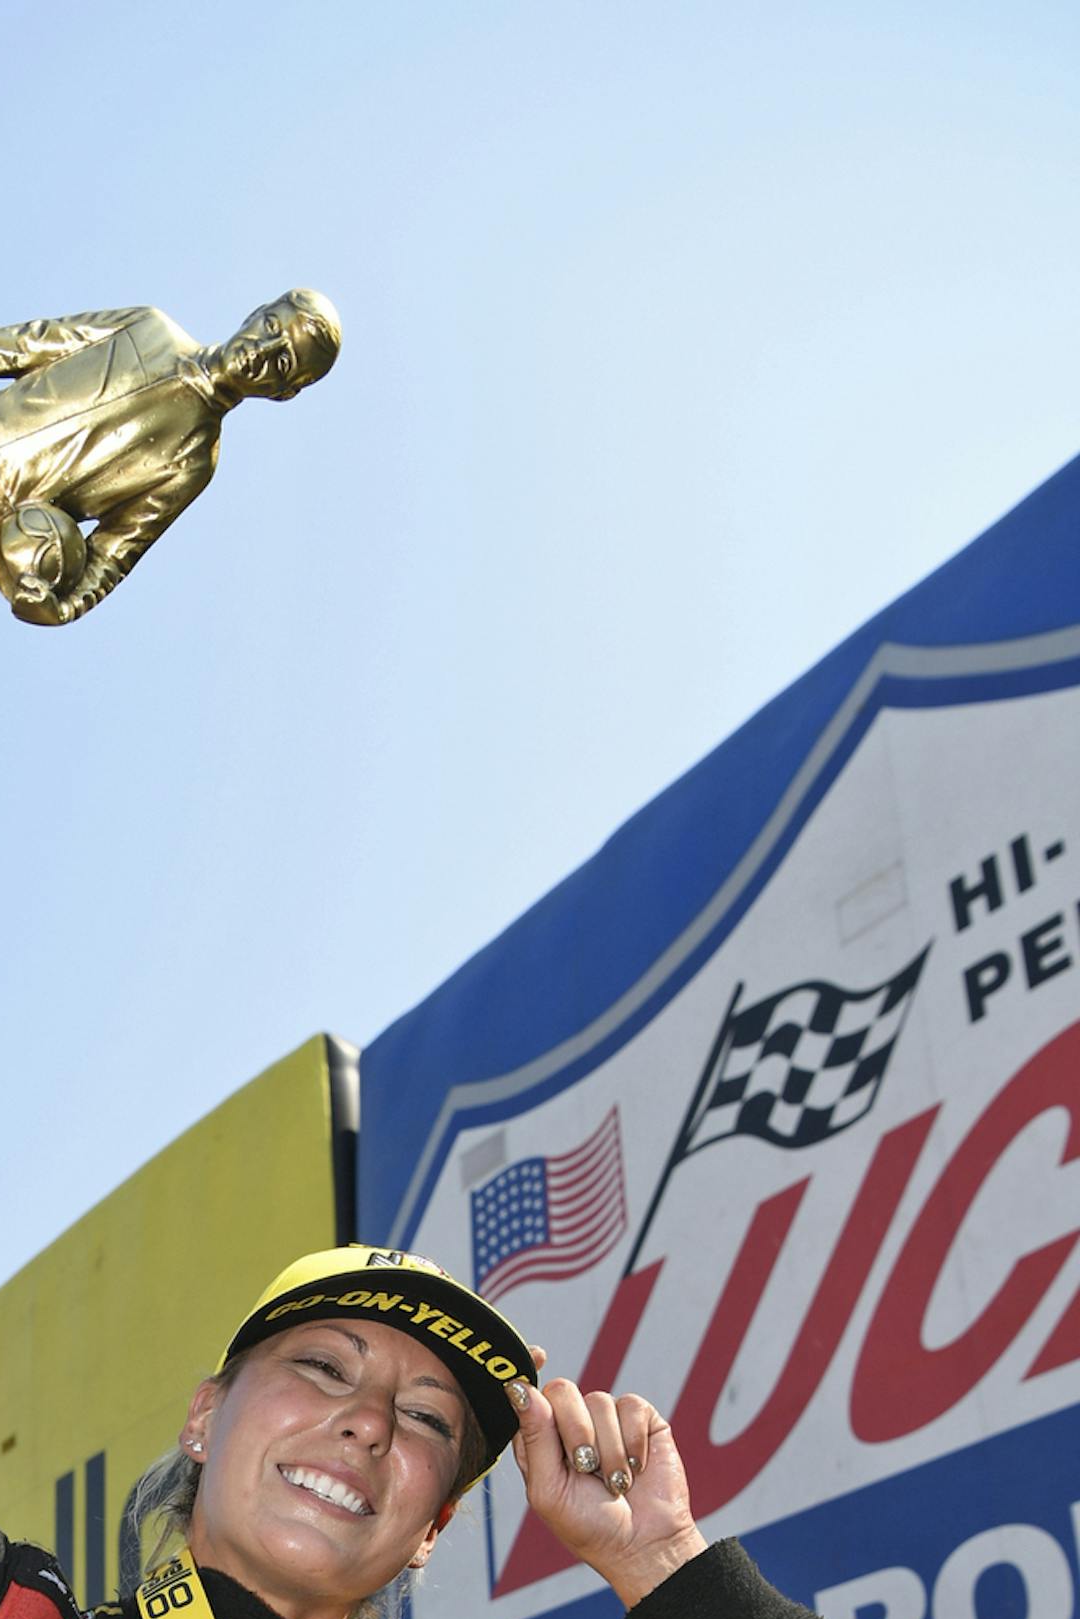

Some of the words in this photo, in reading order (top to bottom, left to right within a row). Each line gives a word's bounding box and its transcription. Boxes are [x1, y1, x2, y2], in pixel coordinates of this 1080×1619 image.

[947, 832, 1066, 934] HI-
[962, 899, 1080, 1025] PE
[491, 1015, 1080, 1602] LUC
